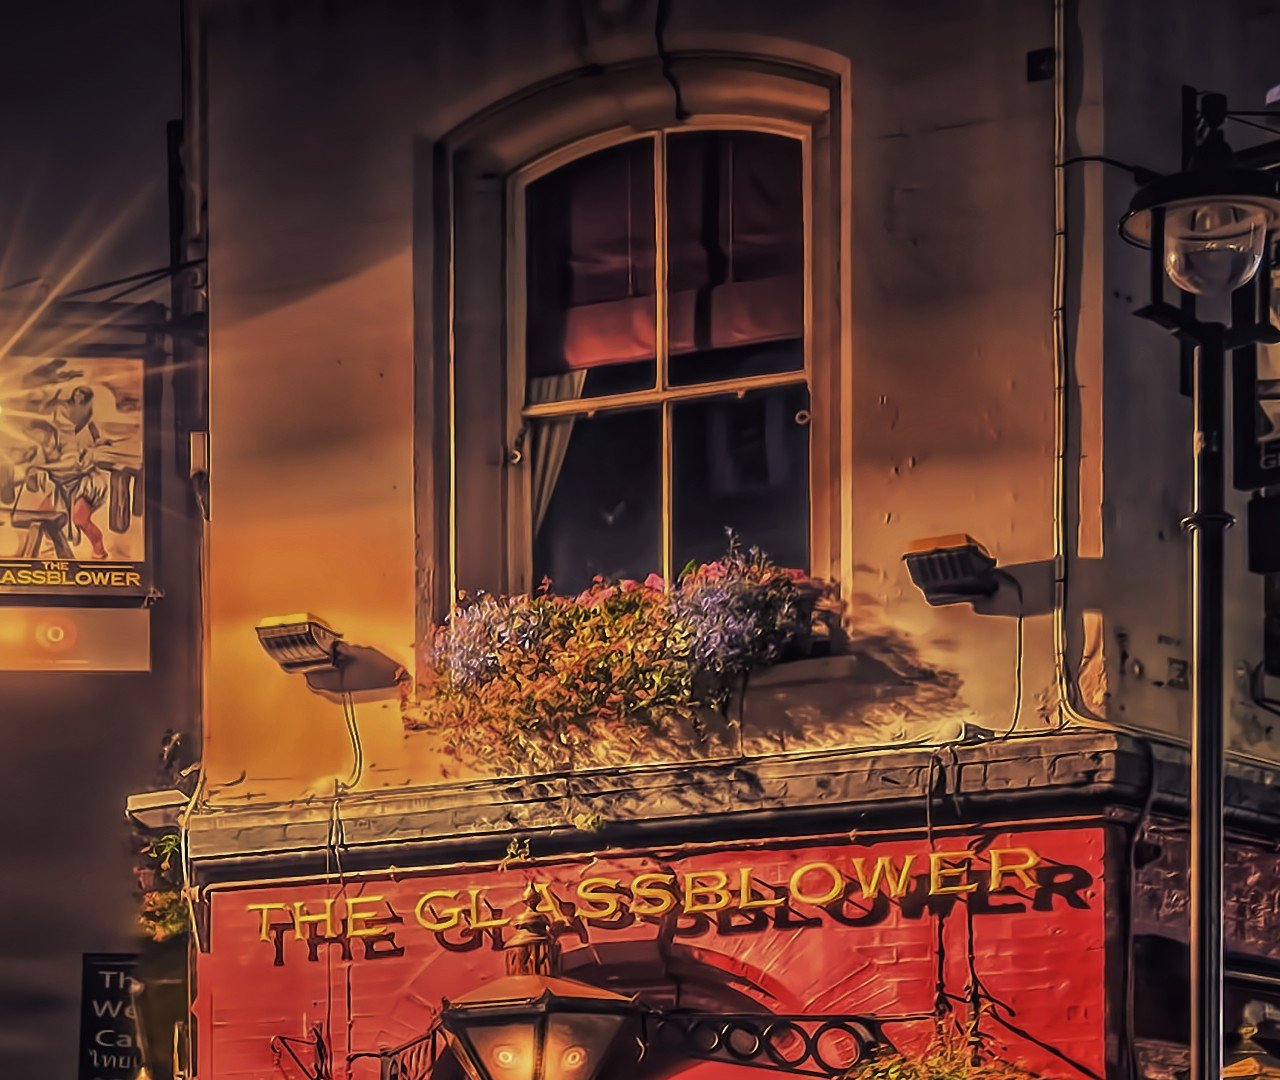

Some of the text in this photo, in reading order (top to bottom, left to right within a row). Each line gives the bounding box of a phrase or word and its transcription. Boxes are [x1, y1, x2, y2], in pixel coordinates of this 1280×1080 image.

[41, 561, 69, 571] THE
[247, 846, 1041, 943] THE GLASSBLOWER
[98, 970, 134, 989] Th
